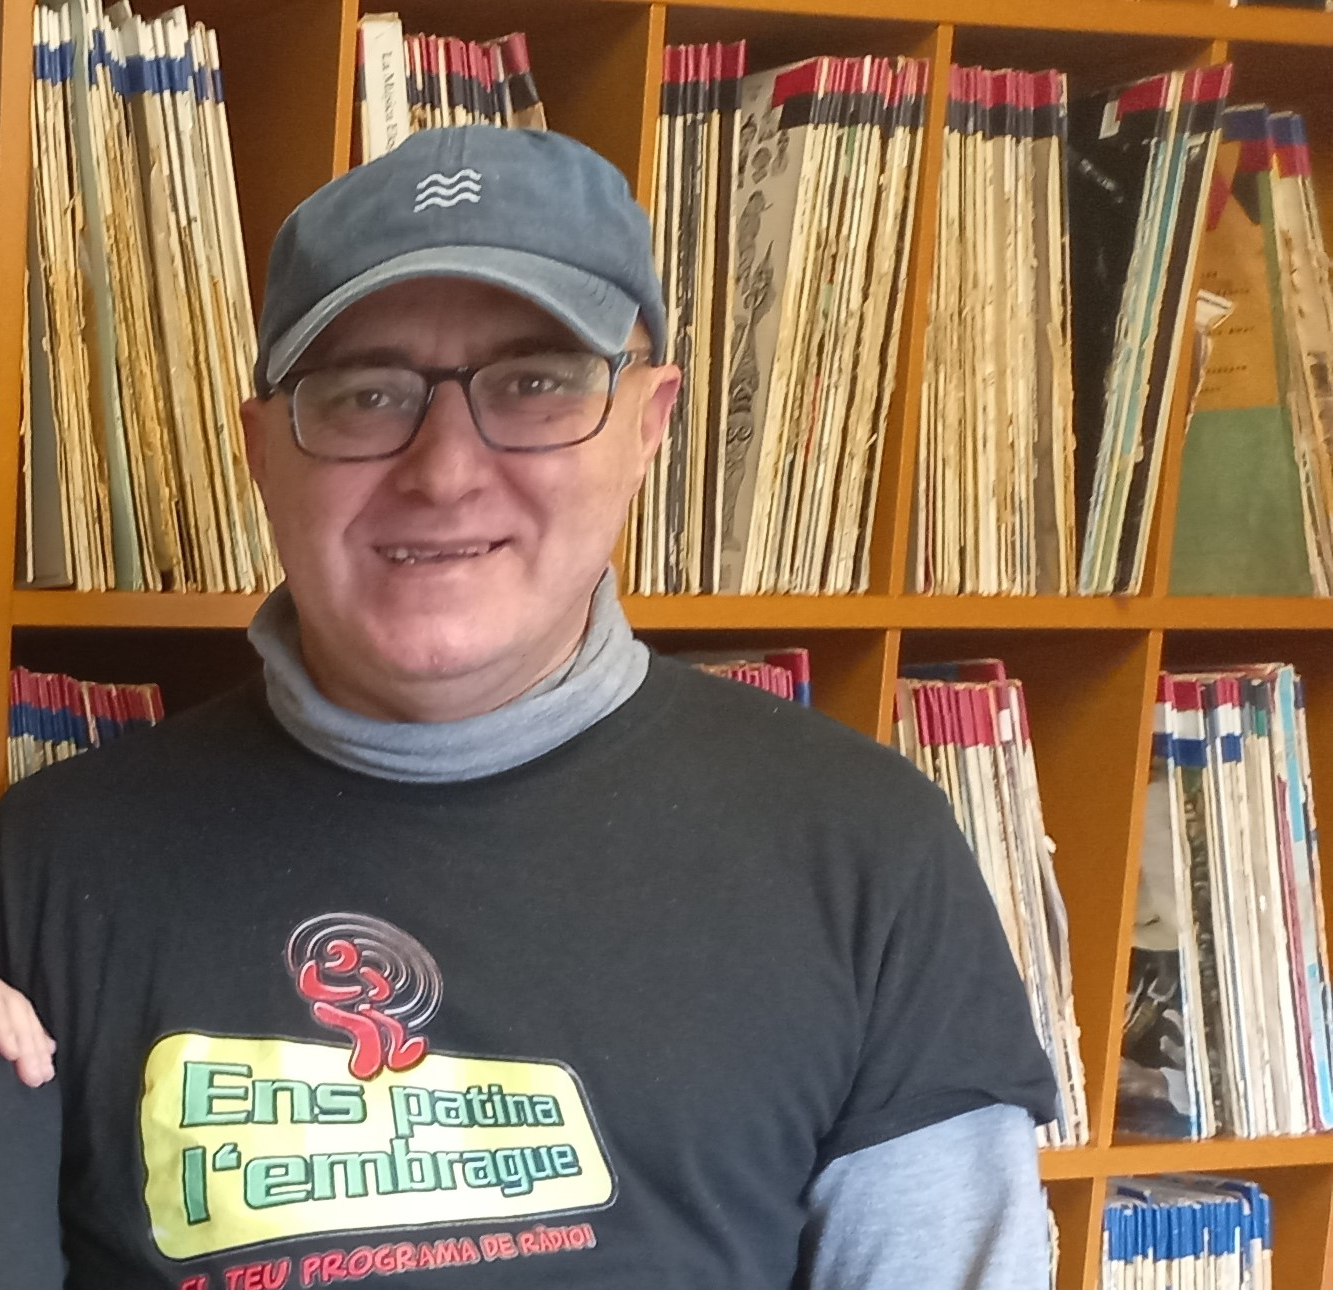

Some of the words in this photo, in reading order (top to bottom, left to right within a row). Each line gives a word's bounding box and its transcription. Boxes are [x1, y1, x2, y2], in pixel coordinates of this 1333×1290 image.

[179, 1058, 367, 1129] Ens
[389, 1083, 566, 1140] patina
[300, 1236, 480, 1290] PROGRAMA
[480, 1231, 517, 1261] DE
